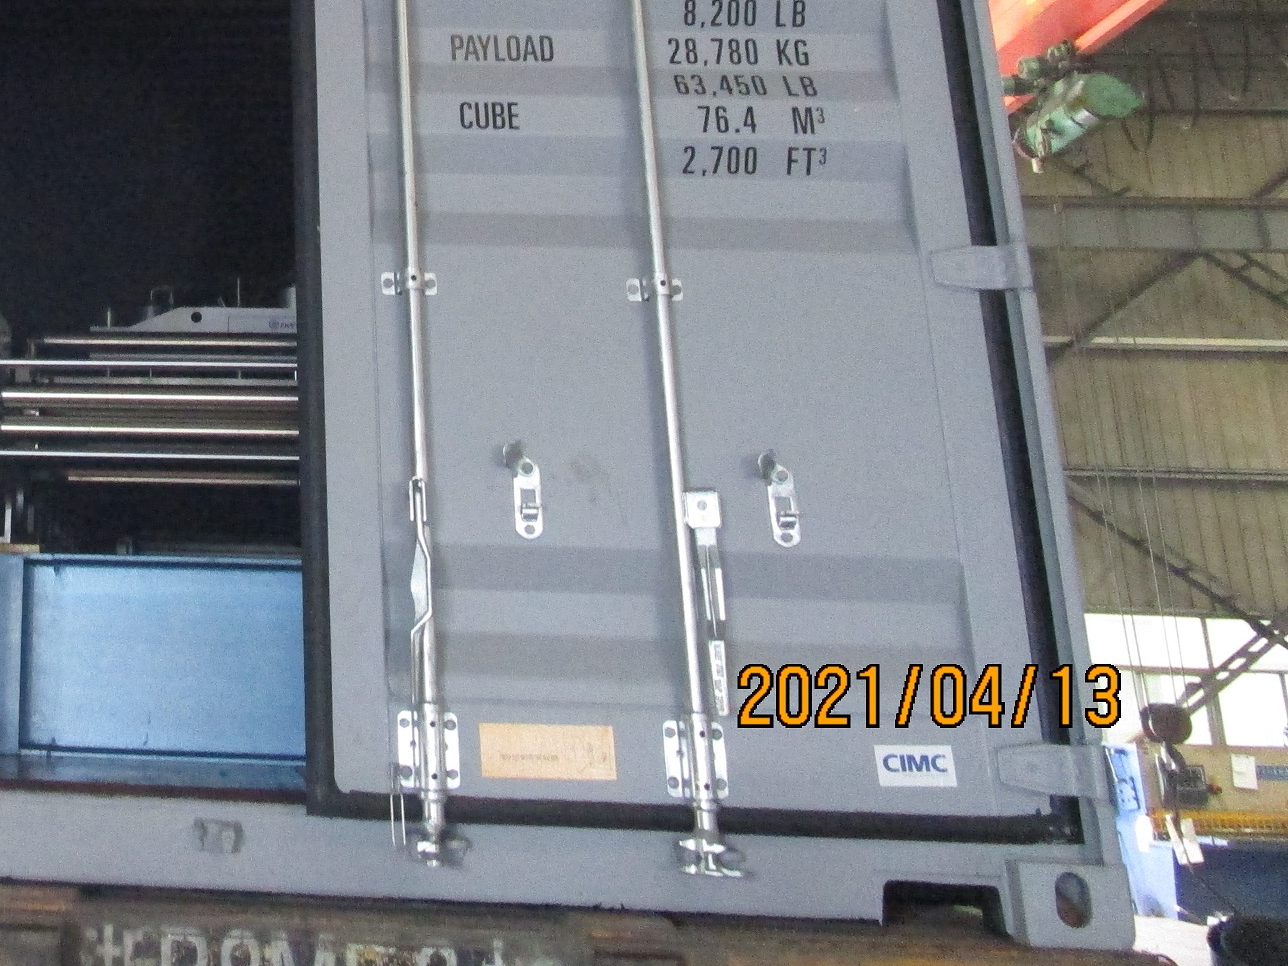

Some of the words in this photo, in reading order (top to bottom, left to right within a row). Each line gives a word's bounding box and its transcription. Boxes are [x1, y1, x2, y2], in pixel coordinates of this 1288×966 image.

[683, 0, 757, 29] 8,200
[775, 0, 806, 28] LB
[449, 34, 555, 63] PAYLOAD
[667, 38, 759, 67] 28,780
[776, 38, 811, 66] KG
[782, 76, 818, 97] LB
[459, 101, 521, 131] CUBE
[697, 106, 757, 134] 76.4
[683, 146, 758, 178] 2,700
[882, 753, 948, 773] CIMC
